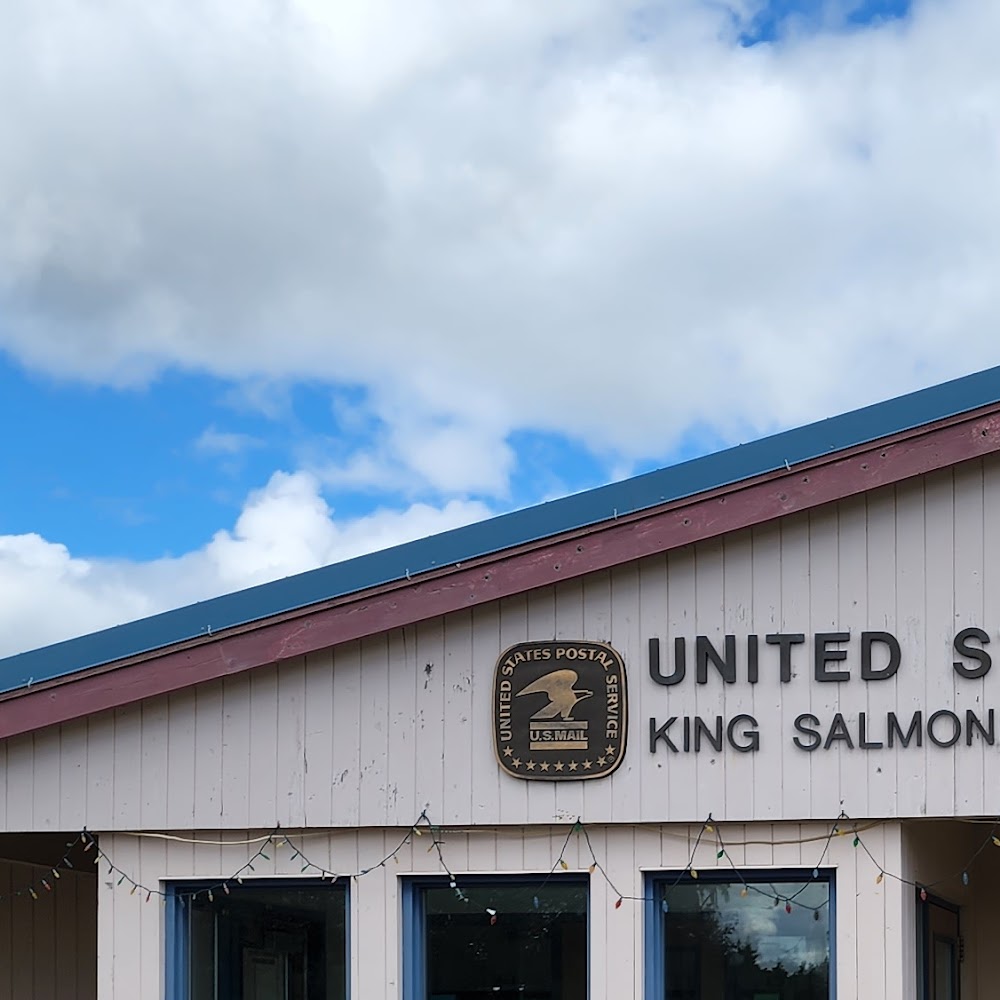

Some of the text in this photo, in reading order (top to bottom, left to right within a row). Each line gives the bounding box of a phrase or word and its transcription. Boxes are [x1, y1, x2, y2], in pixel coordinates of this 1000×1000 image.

[648, 631, 902, 686] UNITED
[500, 648, 619, 742] UNITED STATES POSTAL SERVICE
[649, 713, 760, 754] KING
